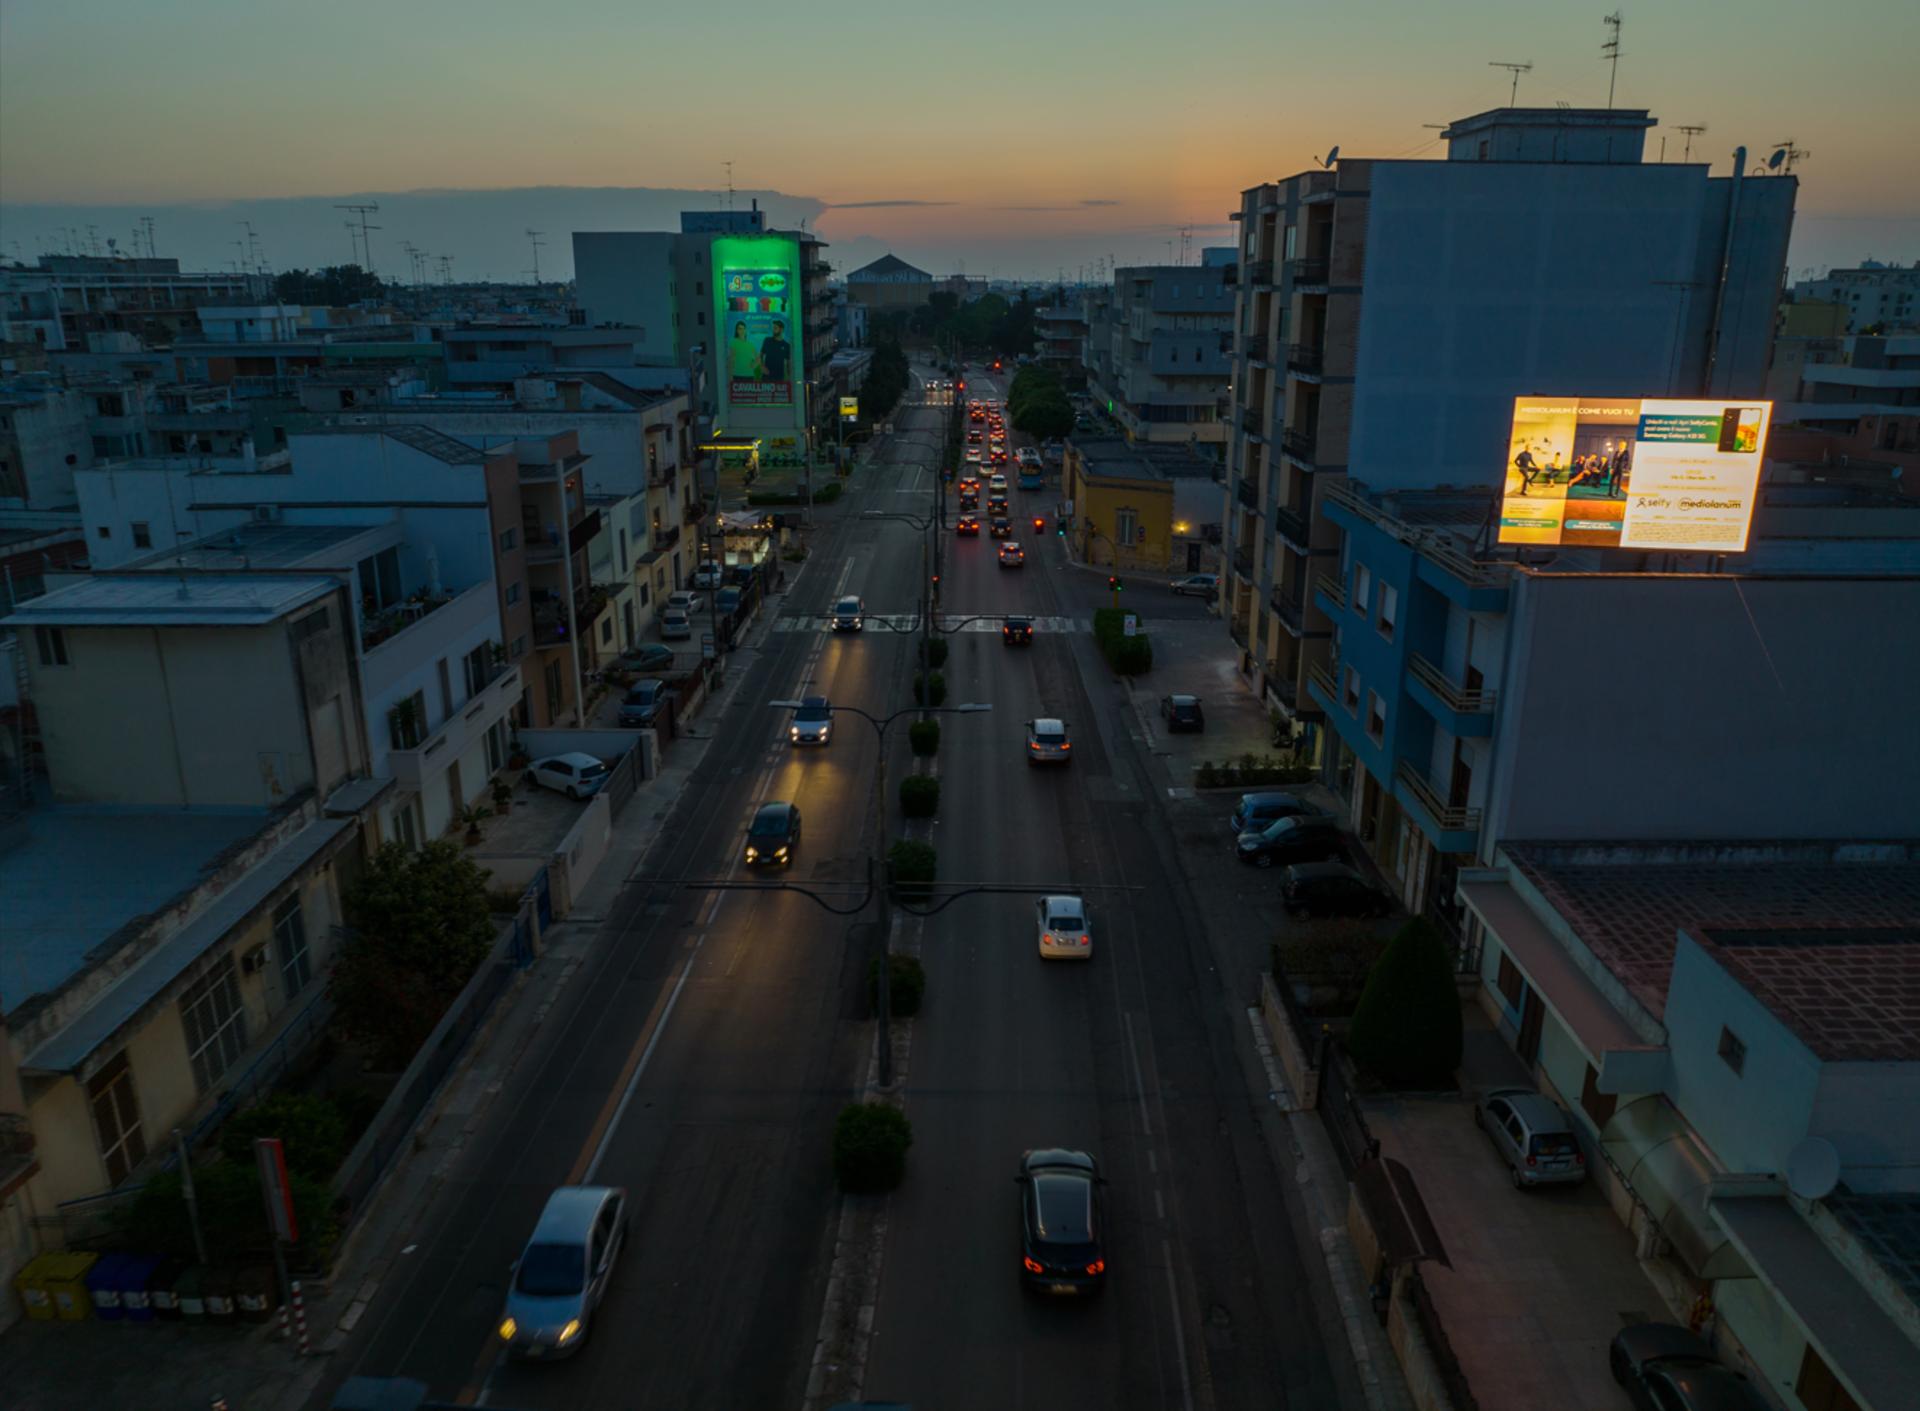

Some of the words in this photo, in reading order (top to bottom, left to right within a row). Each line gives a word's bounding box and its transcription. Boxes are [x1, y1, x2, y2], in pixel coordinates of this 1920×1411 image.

[732, 383, 776, 393] CAVALLINO
[1602, 408, 1622, 416] VUOI
[1623, 408, 1634, 416] TU
[1680, 498, 1741, 509] mediolanum
